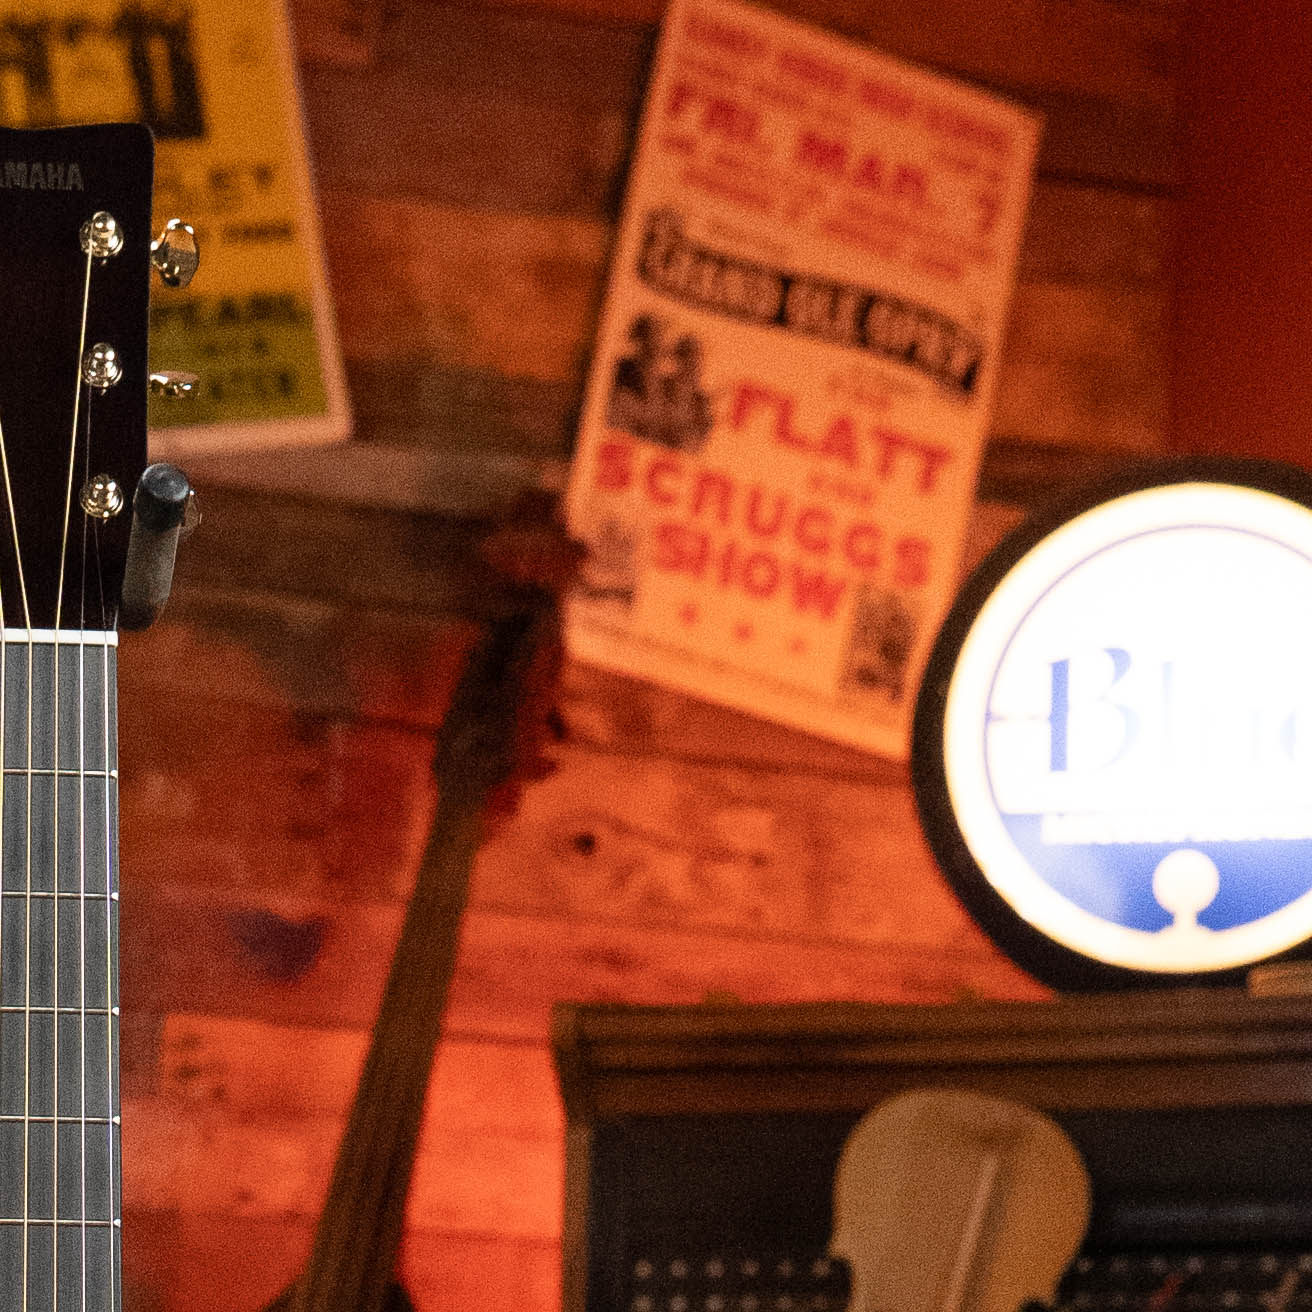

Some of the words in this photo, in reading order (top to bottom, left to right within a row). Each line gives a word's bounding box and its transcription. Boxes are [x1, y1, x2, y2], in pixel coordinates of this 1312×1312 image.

[728, 381, 956, 497] FLATT
[594, 441, 933, 590] SCRUGGS
[650, 522, 848, 621] SHOW
